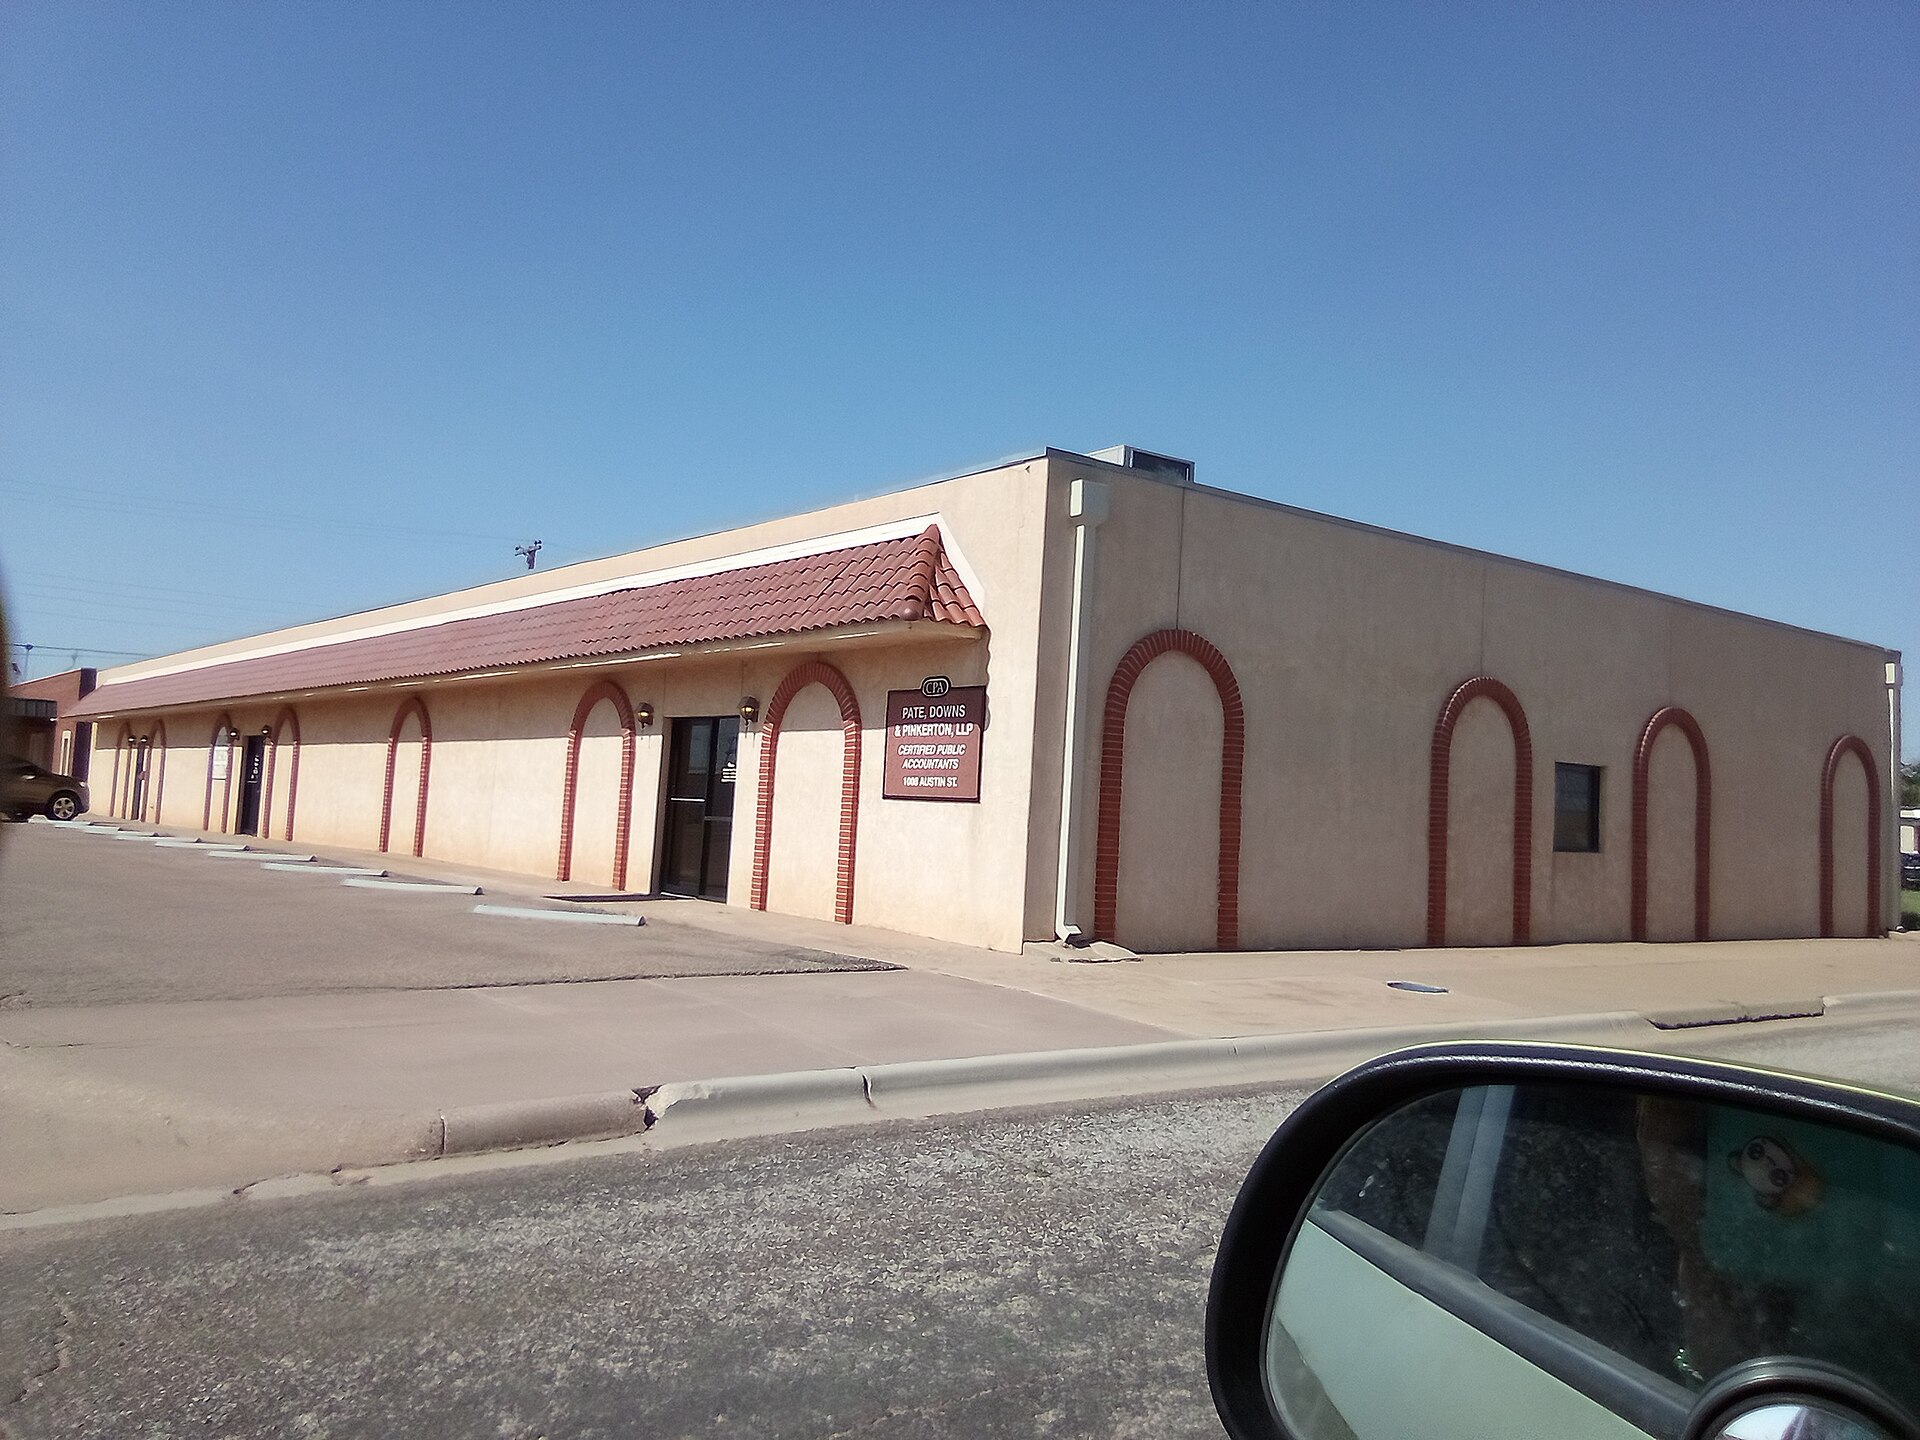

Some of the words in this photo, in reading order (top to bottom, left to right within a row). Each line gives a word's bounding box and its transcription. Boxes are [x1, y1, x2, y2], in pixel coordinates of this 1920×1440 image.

[925, 682, 944, 694] CPA
[902, 706, 927, 719] PATE,
[929, 705, 966, 718] DOWNS
[895, 724, 901, 737] &
[902, 723, 954, 738] PINKERTON,
[956, 722, 974, 736] LLP
[898, 744, 935, 755] CERTIFIED
[936, 744, 966, 755] PUBLIC
[902, 758, 960, 769] ACCOUNTANTS
[919, 776, 946, 787] AUSTIN
